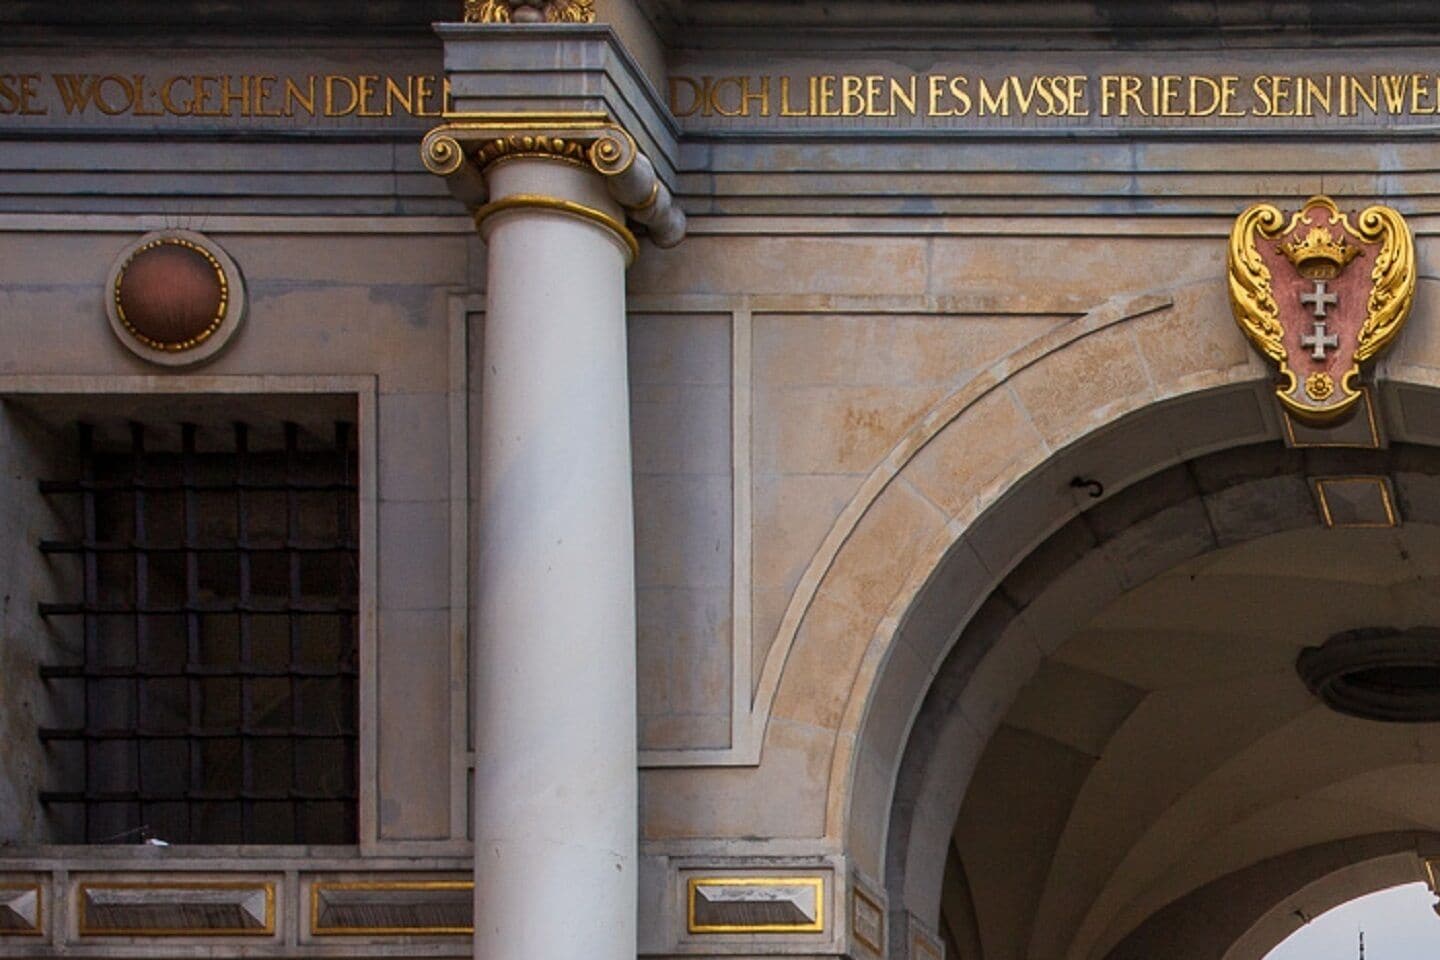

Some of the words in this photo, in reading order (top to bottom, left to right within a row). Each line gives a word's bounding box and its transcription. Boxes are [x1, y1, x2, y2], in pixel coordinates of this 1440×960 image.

[667, 76, 771, 117] DICH
[780, 75, 918, 117] LIEBEN
[928, 75, 974, 117] ES
[979, 75, 1090, 117] MVSSE
[1100, 74, 1246, 117] FRIEDE
[1252, 74, 1335, 117] SEIN
